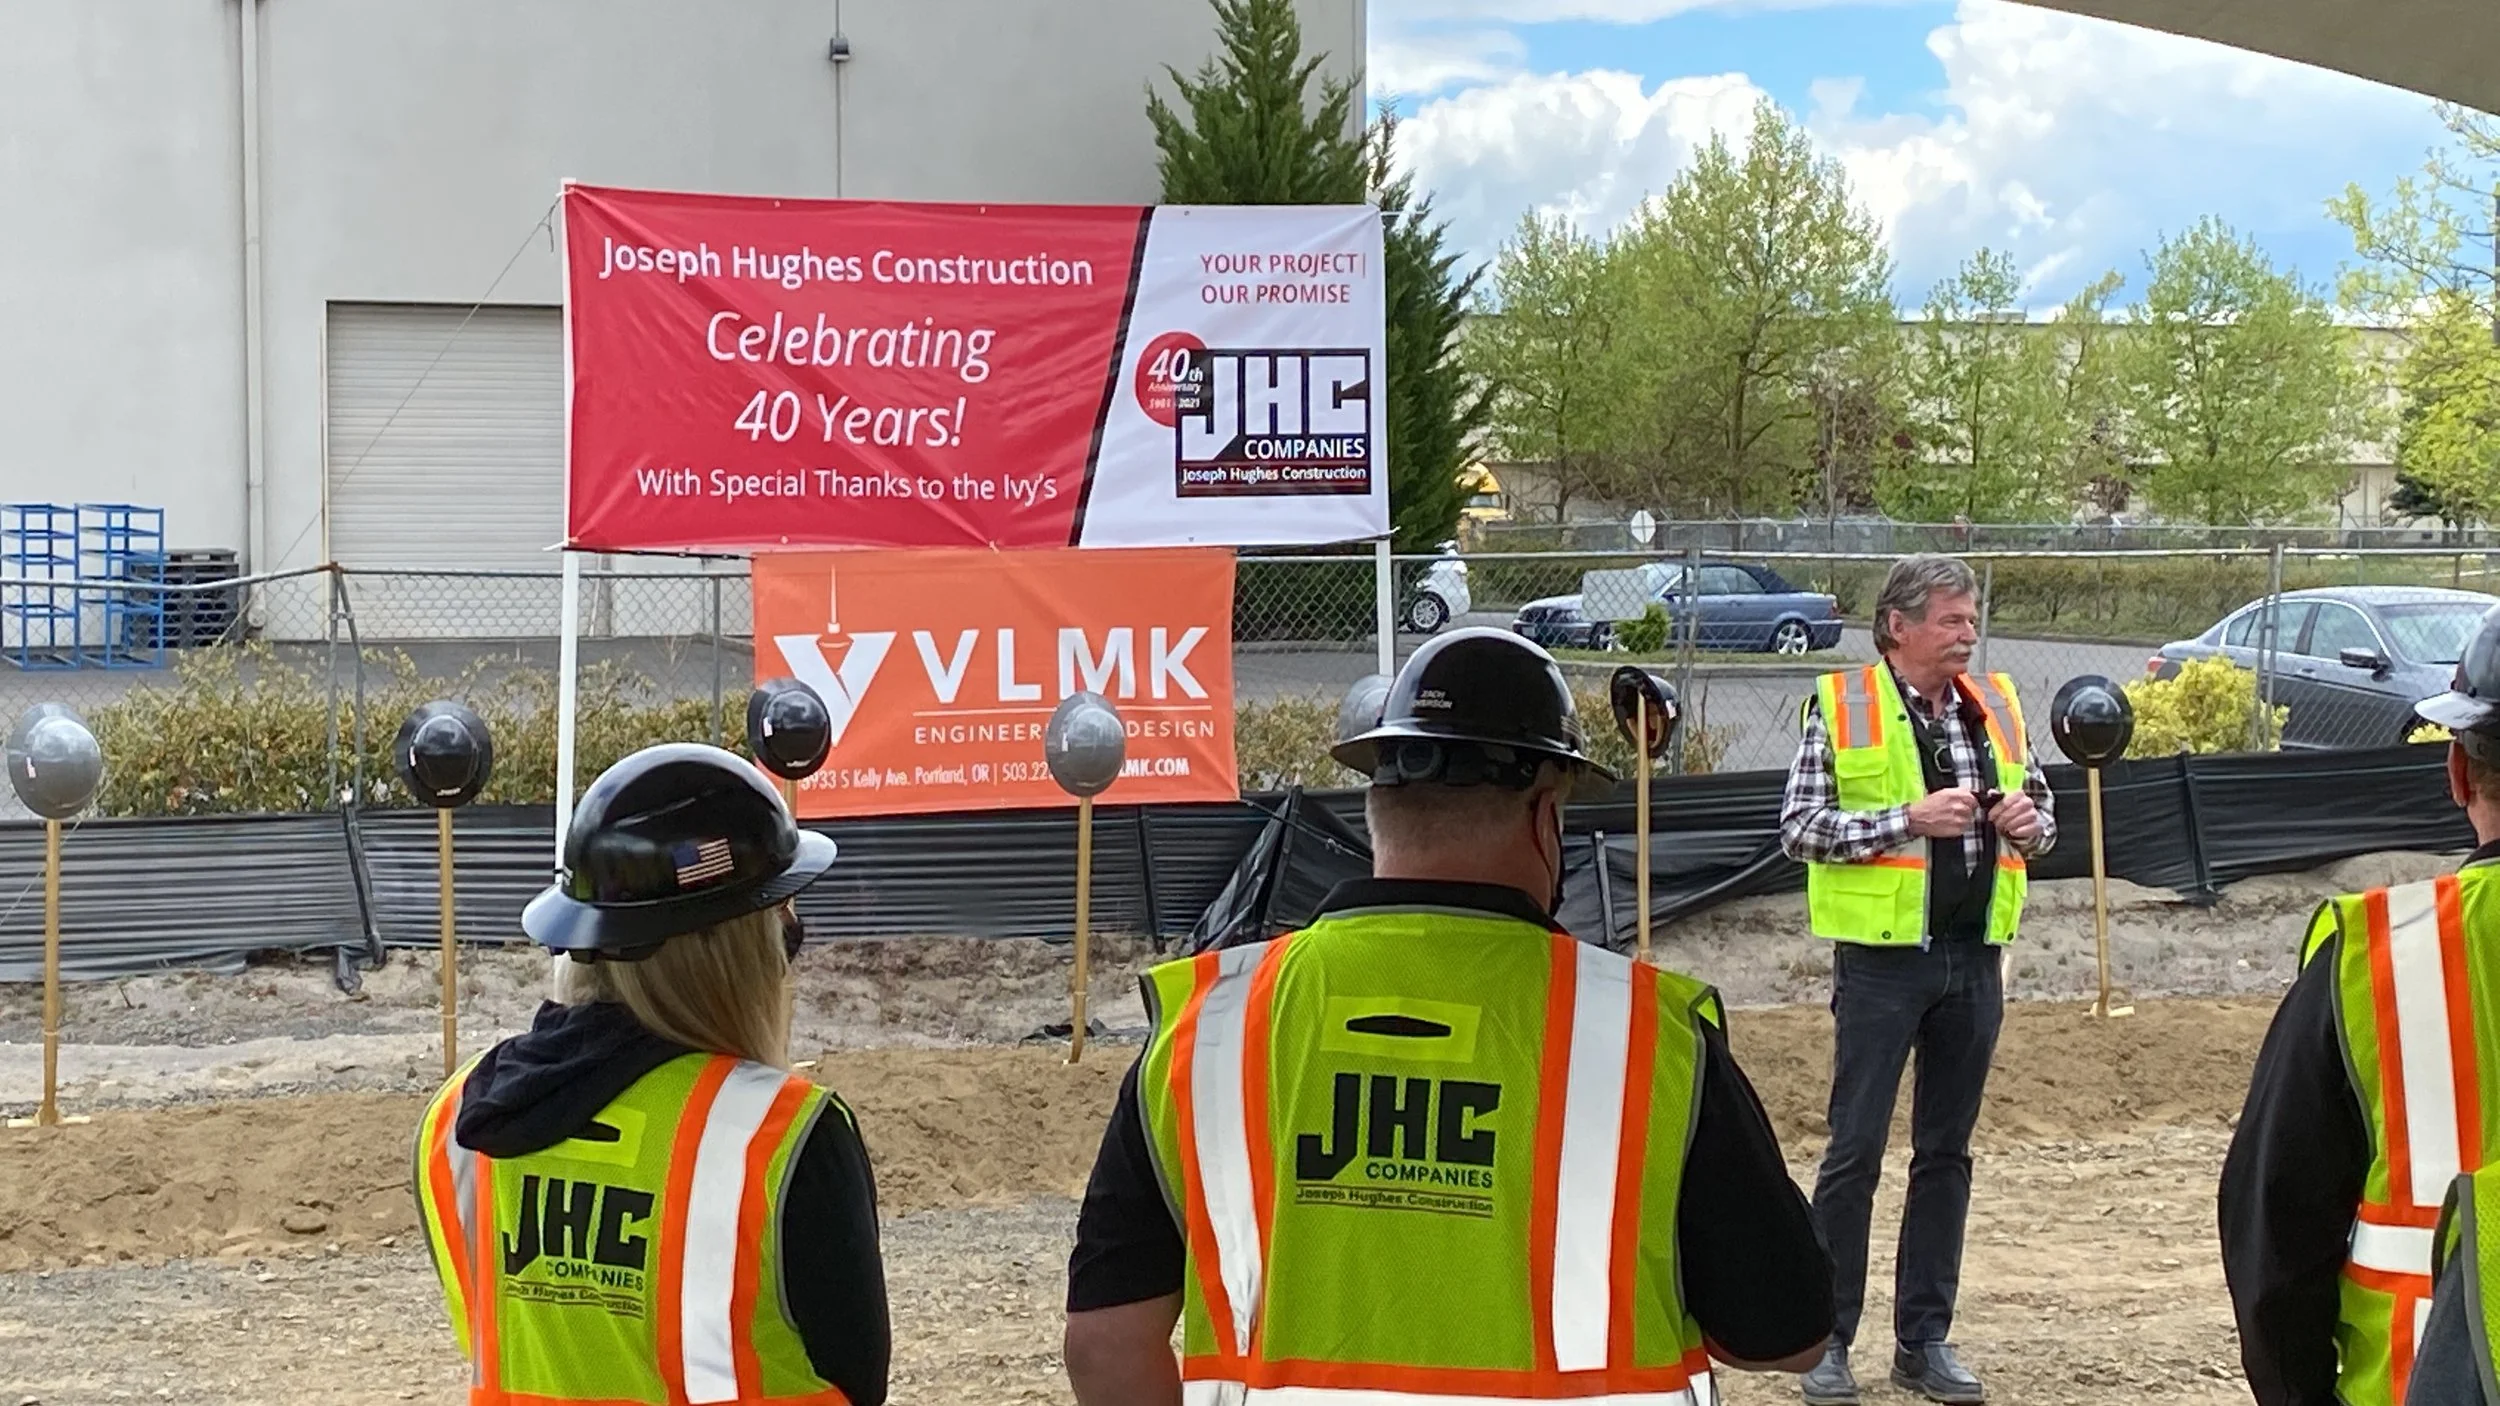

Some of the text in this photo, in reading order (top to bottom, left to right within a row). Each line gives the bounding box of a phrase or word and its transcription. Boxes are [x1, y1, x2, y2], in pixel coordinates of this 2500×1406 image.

[599, 237, 1093, 290] Joseph Hughes Construction
[1200, 253, 1263, 274] YOUR
[1269, 253, 1358, 277] PROJECT
[1201, 283, 1351, 304] OUR PROMISE
[706, 310, 996, 383] Celebrating
[734, 389, 967, 447] 40 Years!
[1181, 355, 1367, 462] JHC
[1244, 437, 1366, 459] COMPANIES
[636, 467, 1058, 507] With Special Thanks to the Ivy's
[1182, 462, 1367, 485] Joseph Hughes Construction
[912, 626, 1210, 704] VLMK
[914, 719, 1215, 745] ENGINEER DESIGN
[841, 769, 850, 789] S
[853, 766, 881, 791] Kelly
[915, 764, 968, 788] Portland,
[972, 763, 989, 783] OR
[1297, 1073, 1502, 1182] JHC
[1365, 1162, 1493, 1189] COMPANIES
[1297, 1187, 1346, 1201] Joseph
[1407, 1193, 1494, 1213] Construction
[502, 1174, 655, 1276] JHC
